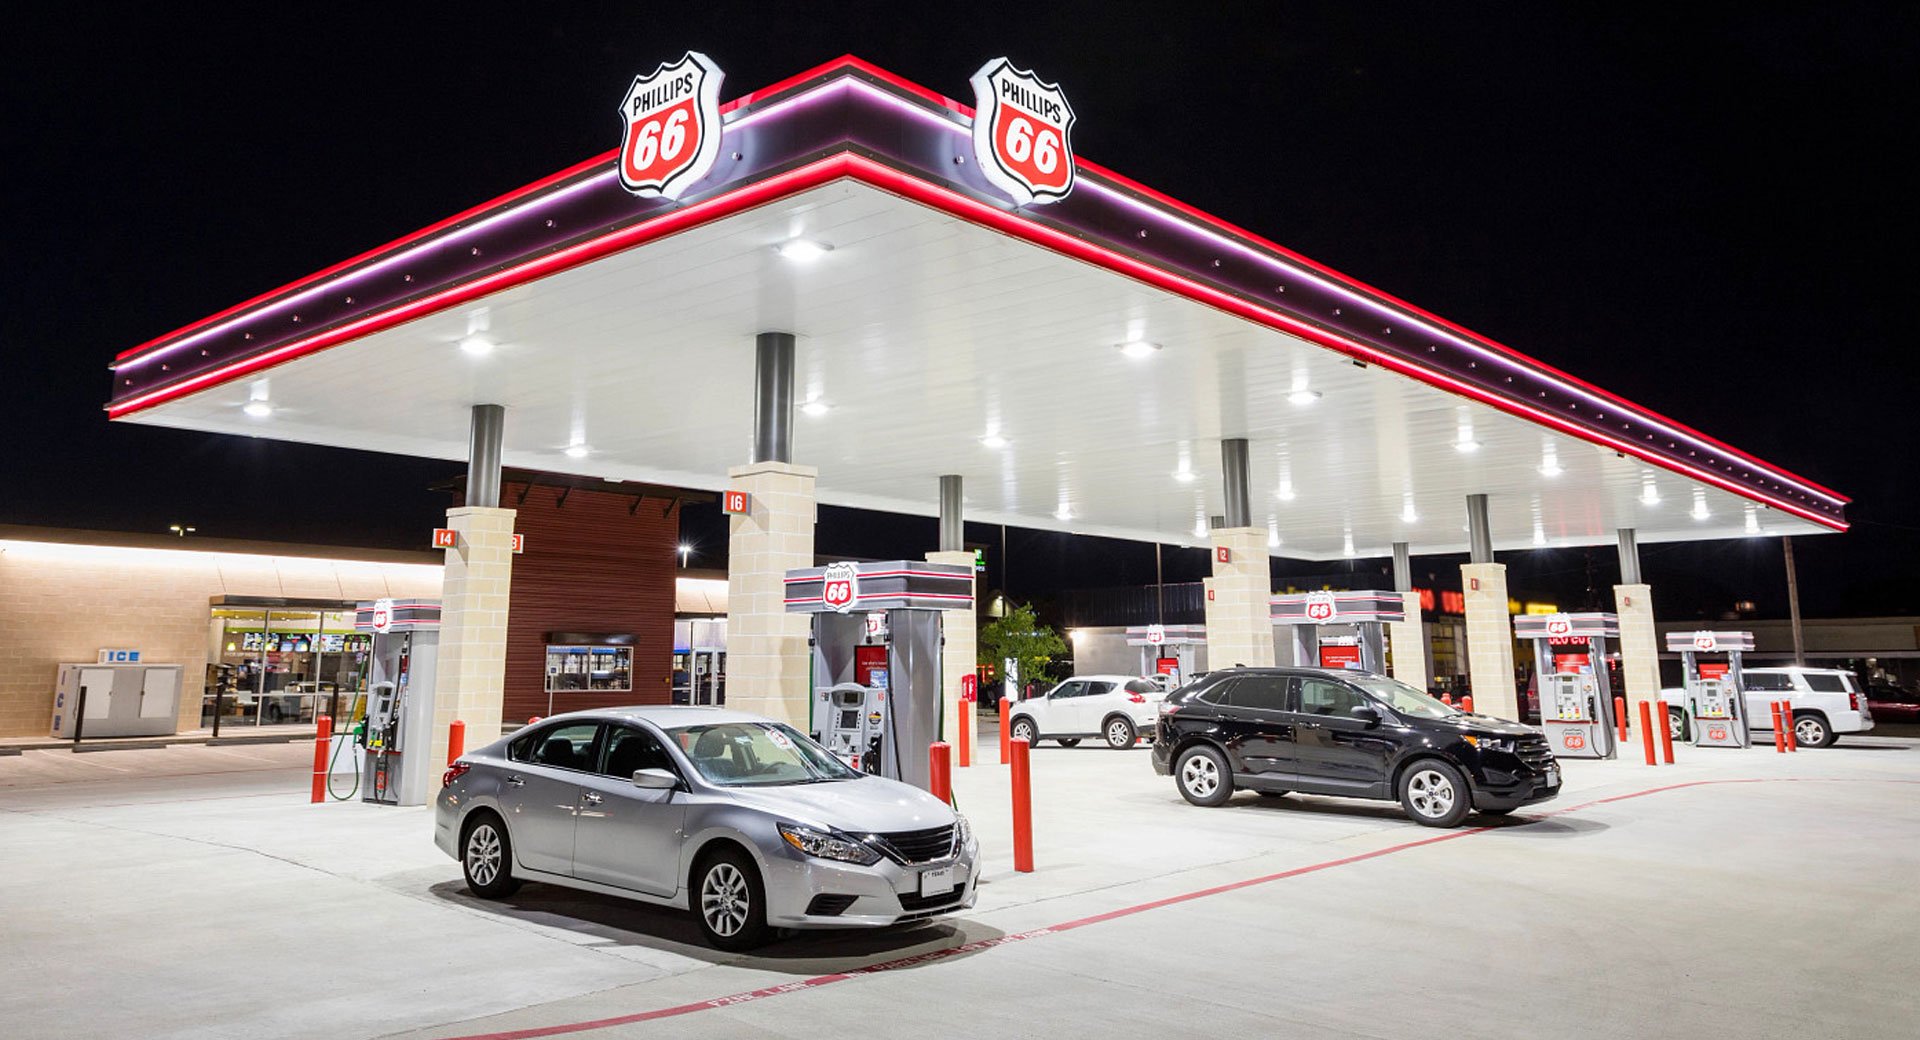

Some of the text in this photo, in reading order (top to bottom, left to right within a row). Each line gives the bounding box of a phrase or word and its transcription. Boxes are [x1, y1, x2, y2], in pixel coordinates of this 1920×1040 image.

[633, 72, 693, 116] PHILLIPS
[1002, 78, 1061, 123] PHILLIPS
[633, 108, 689, 171] 66
[1005, 117, 1061, 174] 66
[730, 493, 744, 511] 16
[439, 532, 452, 545] 14
[826, 570, 851, 579] PHILLIPS
[826, 582, 850, 601] 66
[1310, 604, 1330, 617] 66
[1549, 622, 1568, 633] 66
[108, 651, 140, 661] ICE
